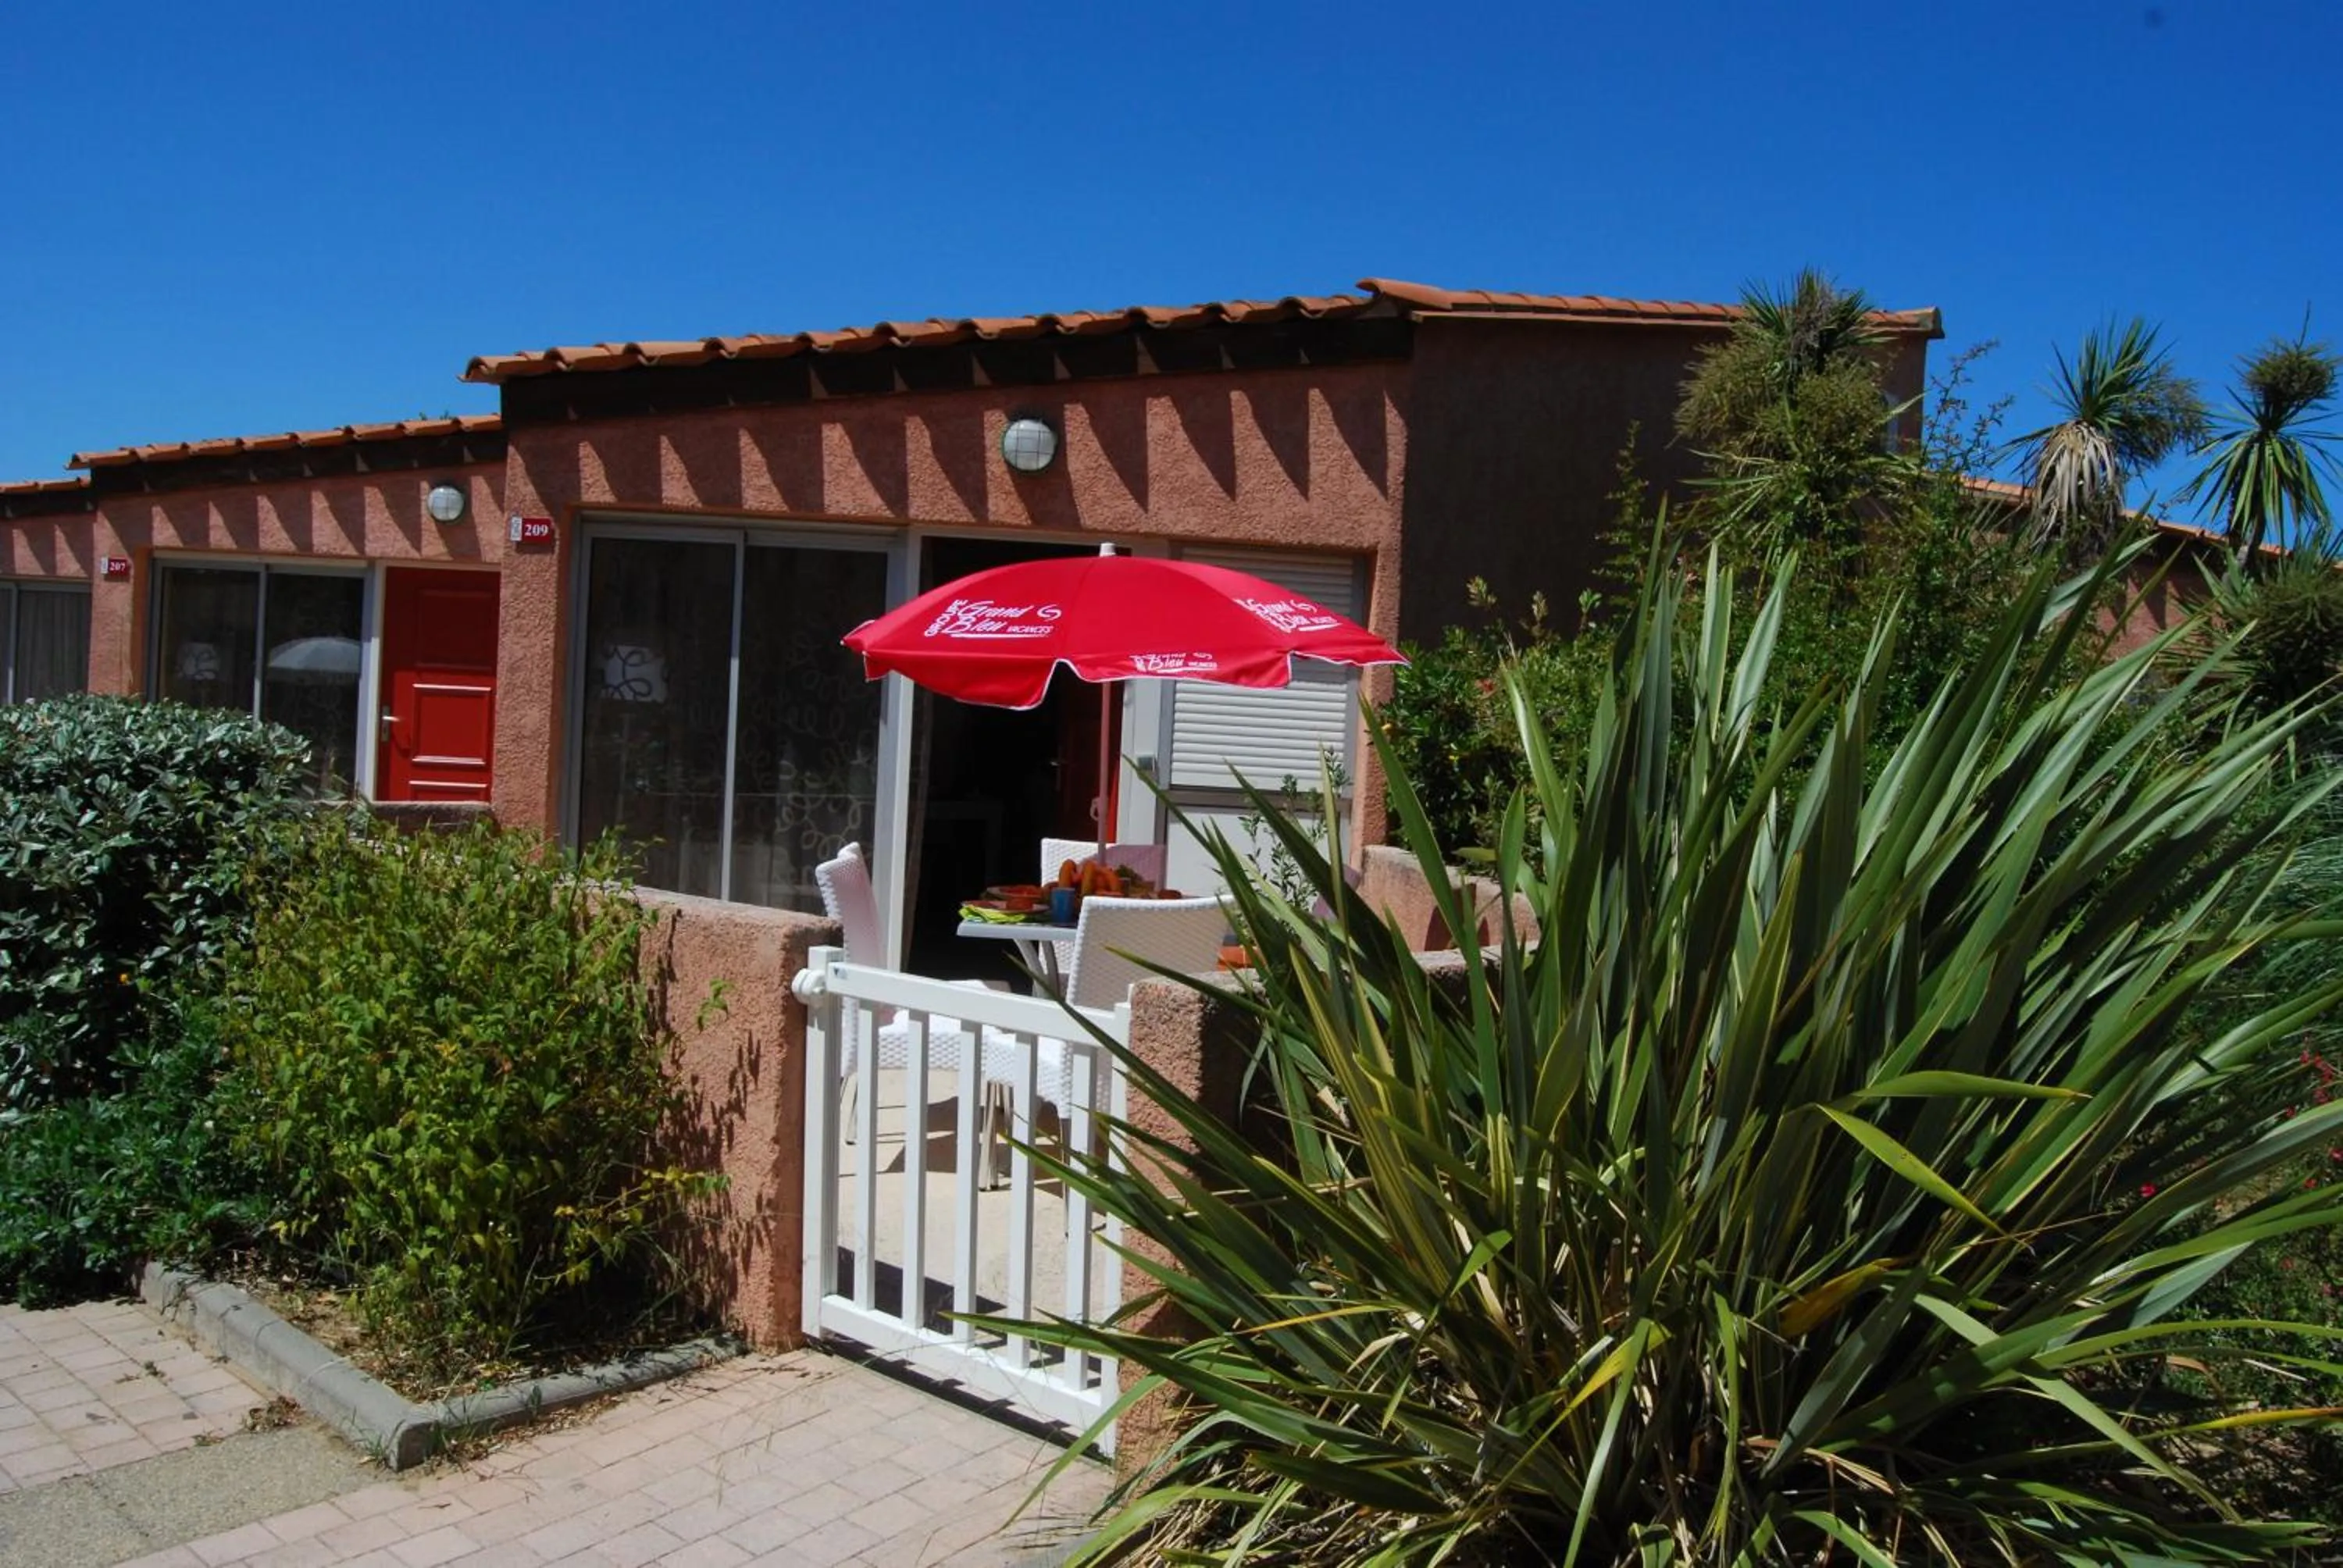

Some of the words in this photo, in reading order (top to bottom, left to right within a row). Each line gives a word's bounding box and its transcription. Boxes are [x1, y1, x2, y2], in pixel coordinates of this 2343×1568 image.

[524, 524, 548, 536] 209
[109, 561, 126, 572] 207
[957, 600, 1034, 618] Grand
